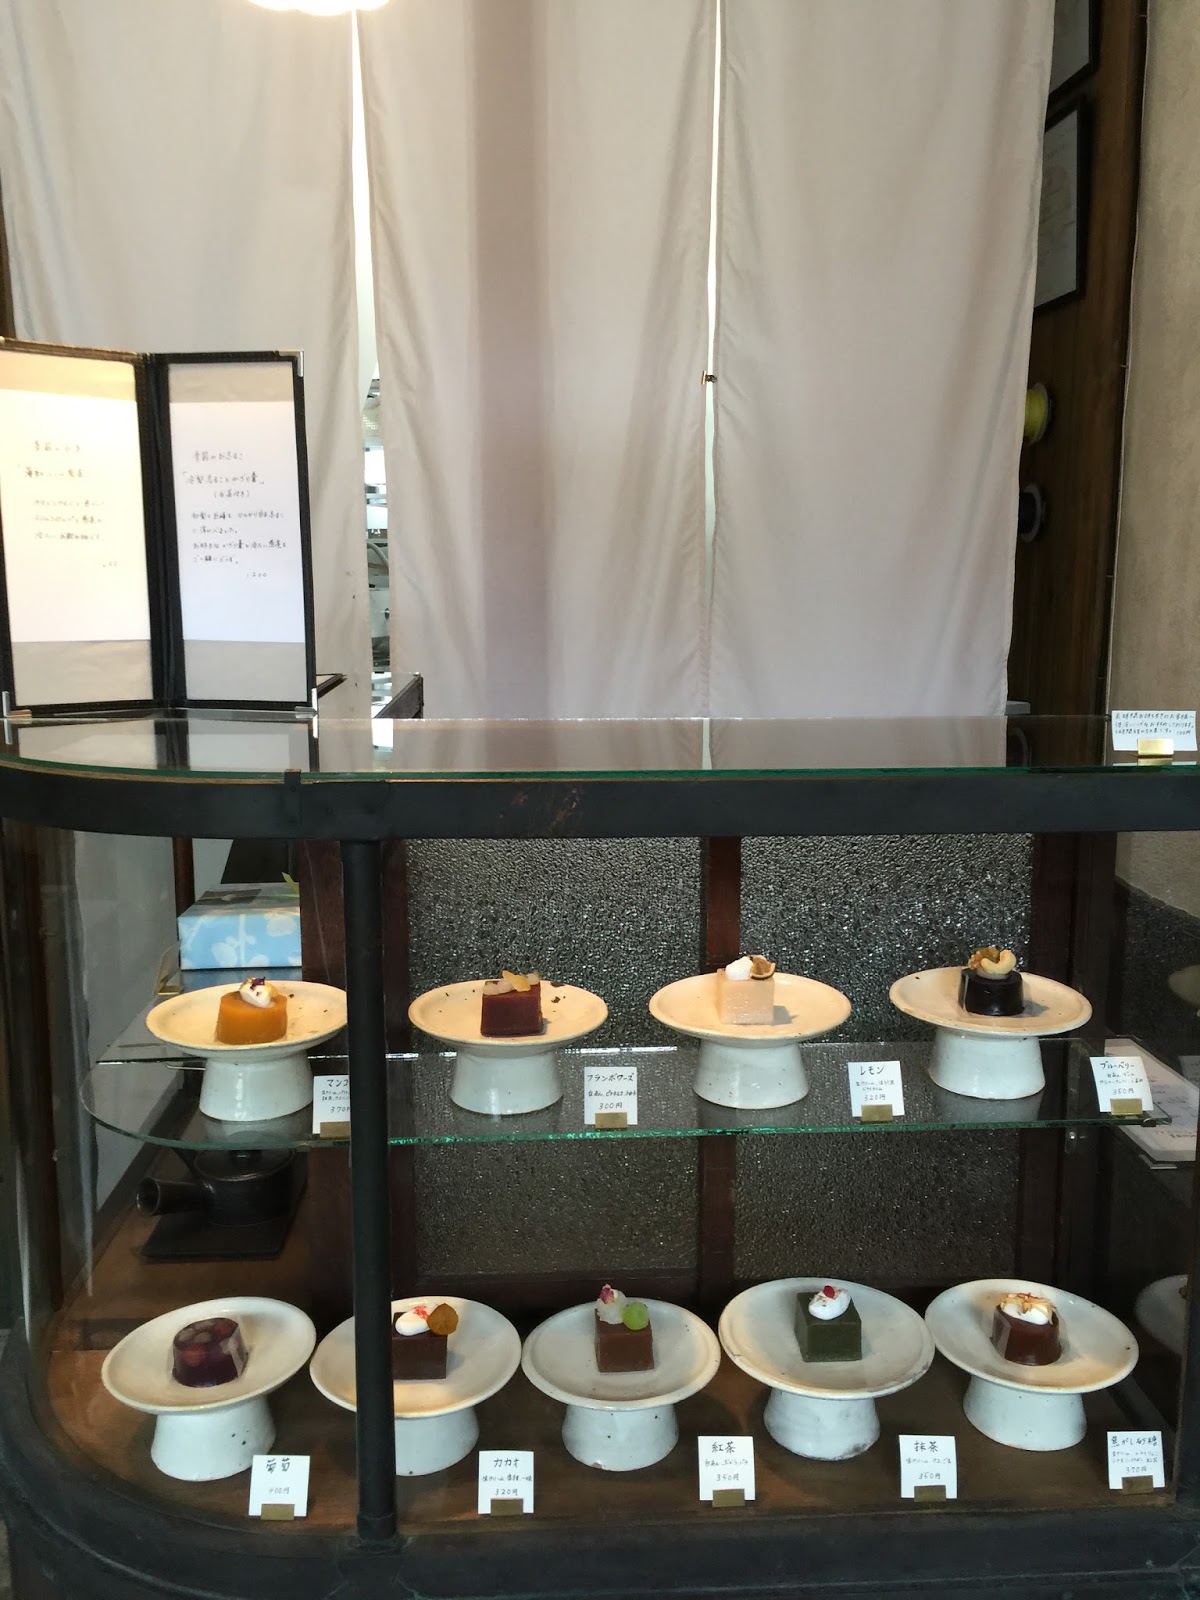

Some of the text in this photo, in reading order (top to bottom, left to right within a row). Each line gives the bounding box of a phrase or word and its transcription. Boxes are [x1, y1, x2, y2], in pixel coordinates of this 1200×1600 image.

[1099, 1060, 1135, 1070] ブルーベリー
[860, 1065, 885, 1076] レモン
[587, 1072, 635, 1082] フランボワーズ
[864, 1093, 886, 1102] 320円
[599, 1102, 623, 1110] 300円
[711, 1441, 736, 1454] 紅茶
[914, 1440, 939, 1453] 抹茶
[493, 1457, 520, 1468] カカオ
[717, 1473, 740, 1481] 350円
[918, 1472, 941, 1480] 350円
[495, 1488, 518, 1496] 320円
